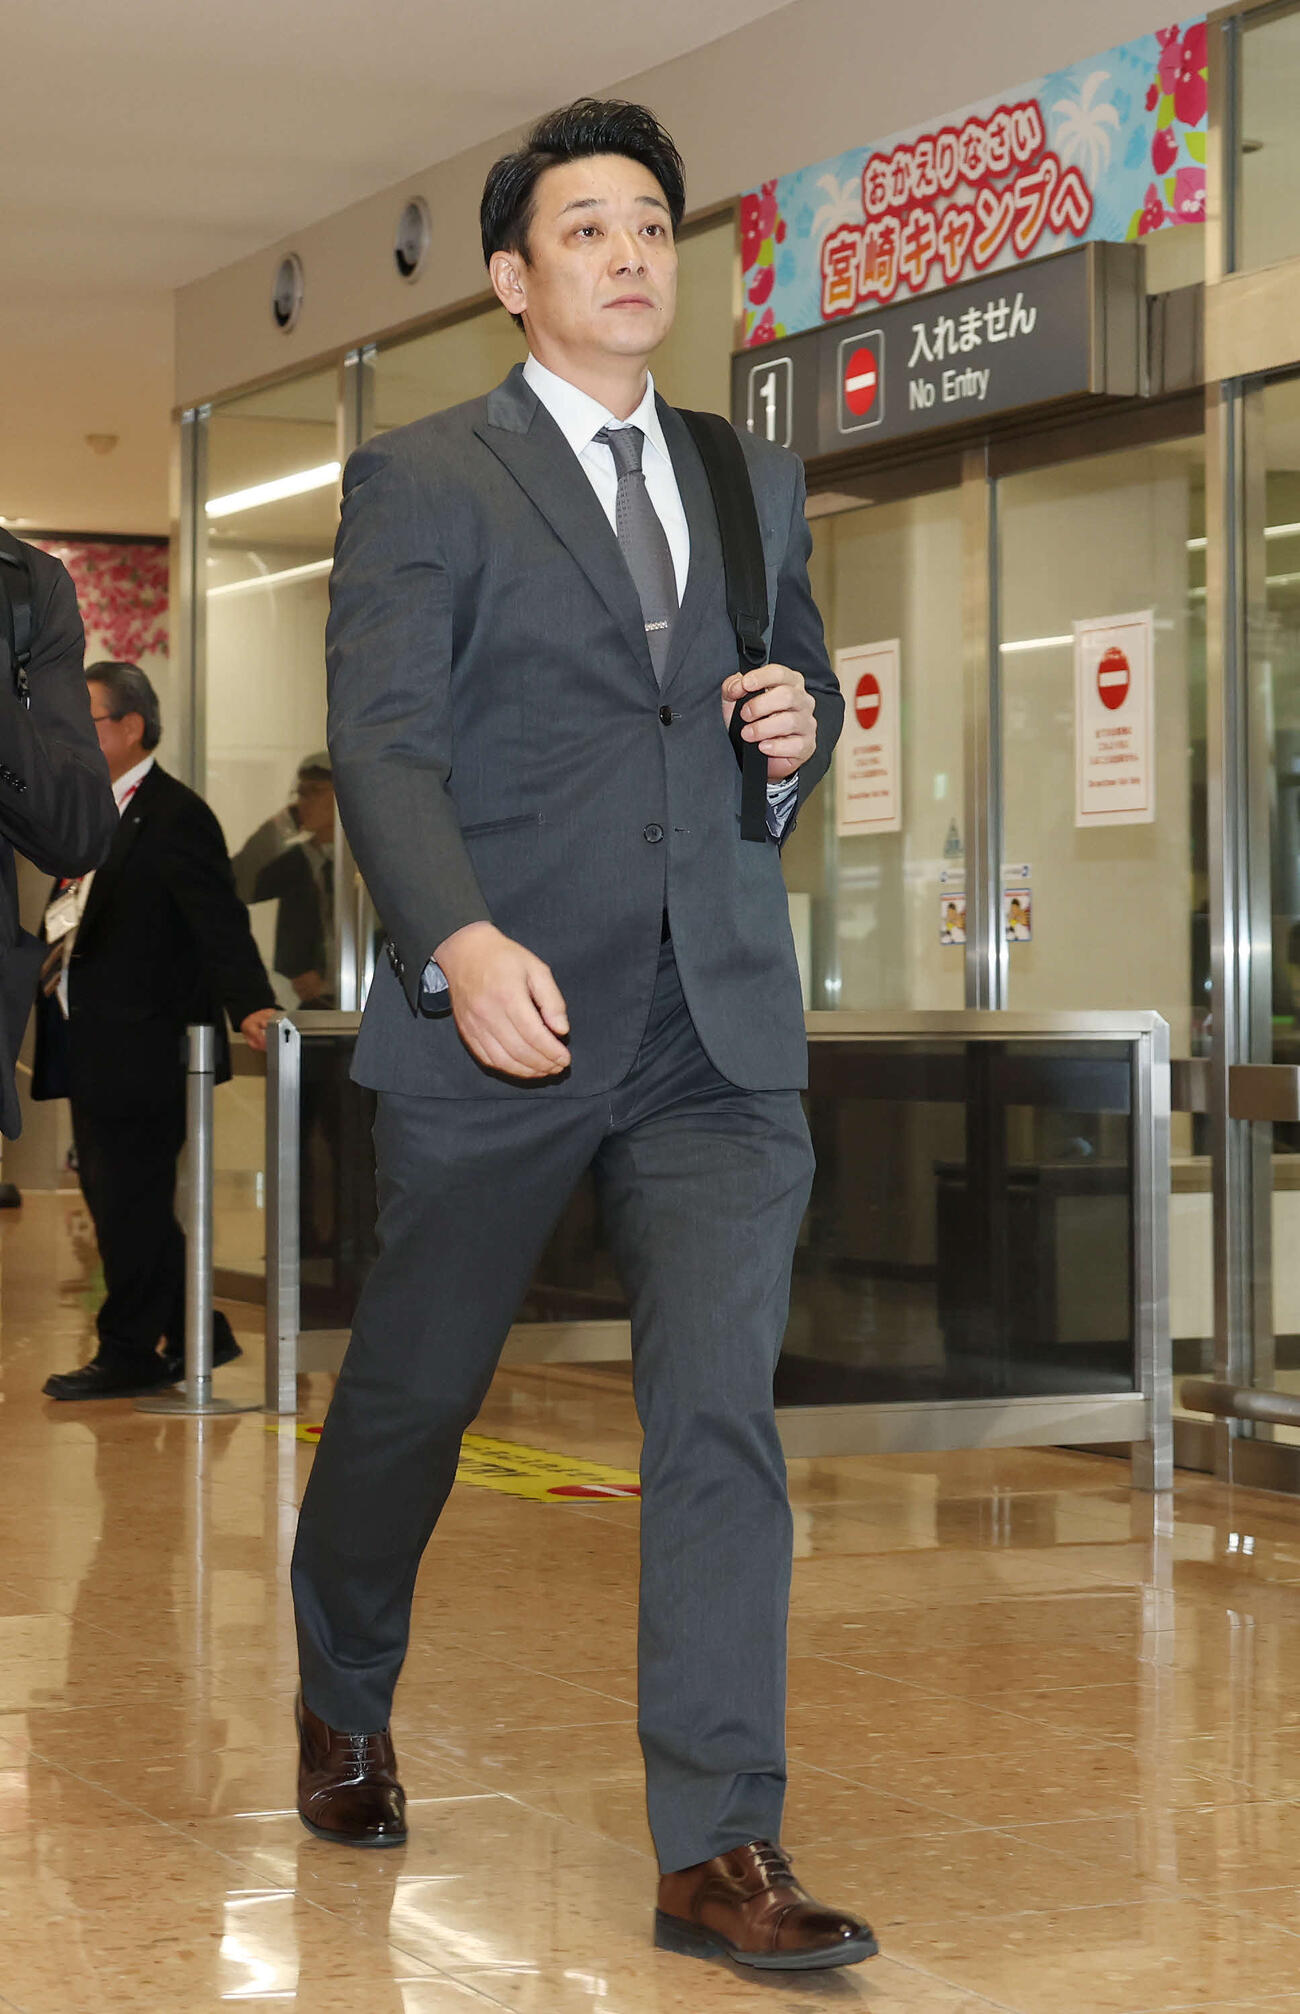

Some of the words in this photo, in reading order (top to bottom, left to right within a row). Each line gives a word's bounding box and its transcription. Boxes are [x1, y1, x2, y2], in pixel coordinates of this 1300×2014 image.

[864, 99, 1045, 214] おかえりなさい
[821, 153, 1092, 318] 宮崎キャンプへ
[908, 292, 1037, 368] 入れません
[759, 372, 777, 441] 1
[908, 378, 936, 411] No
[941, 367, 991, 402] Entry
